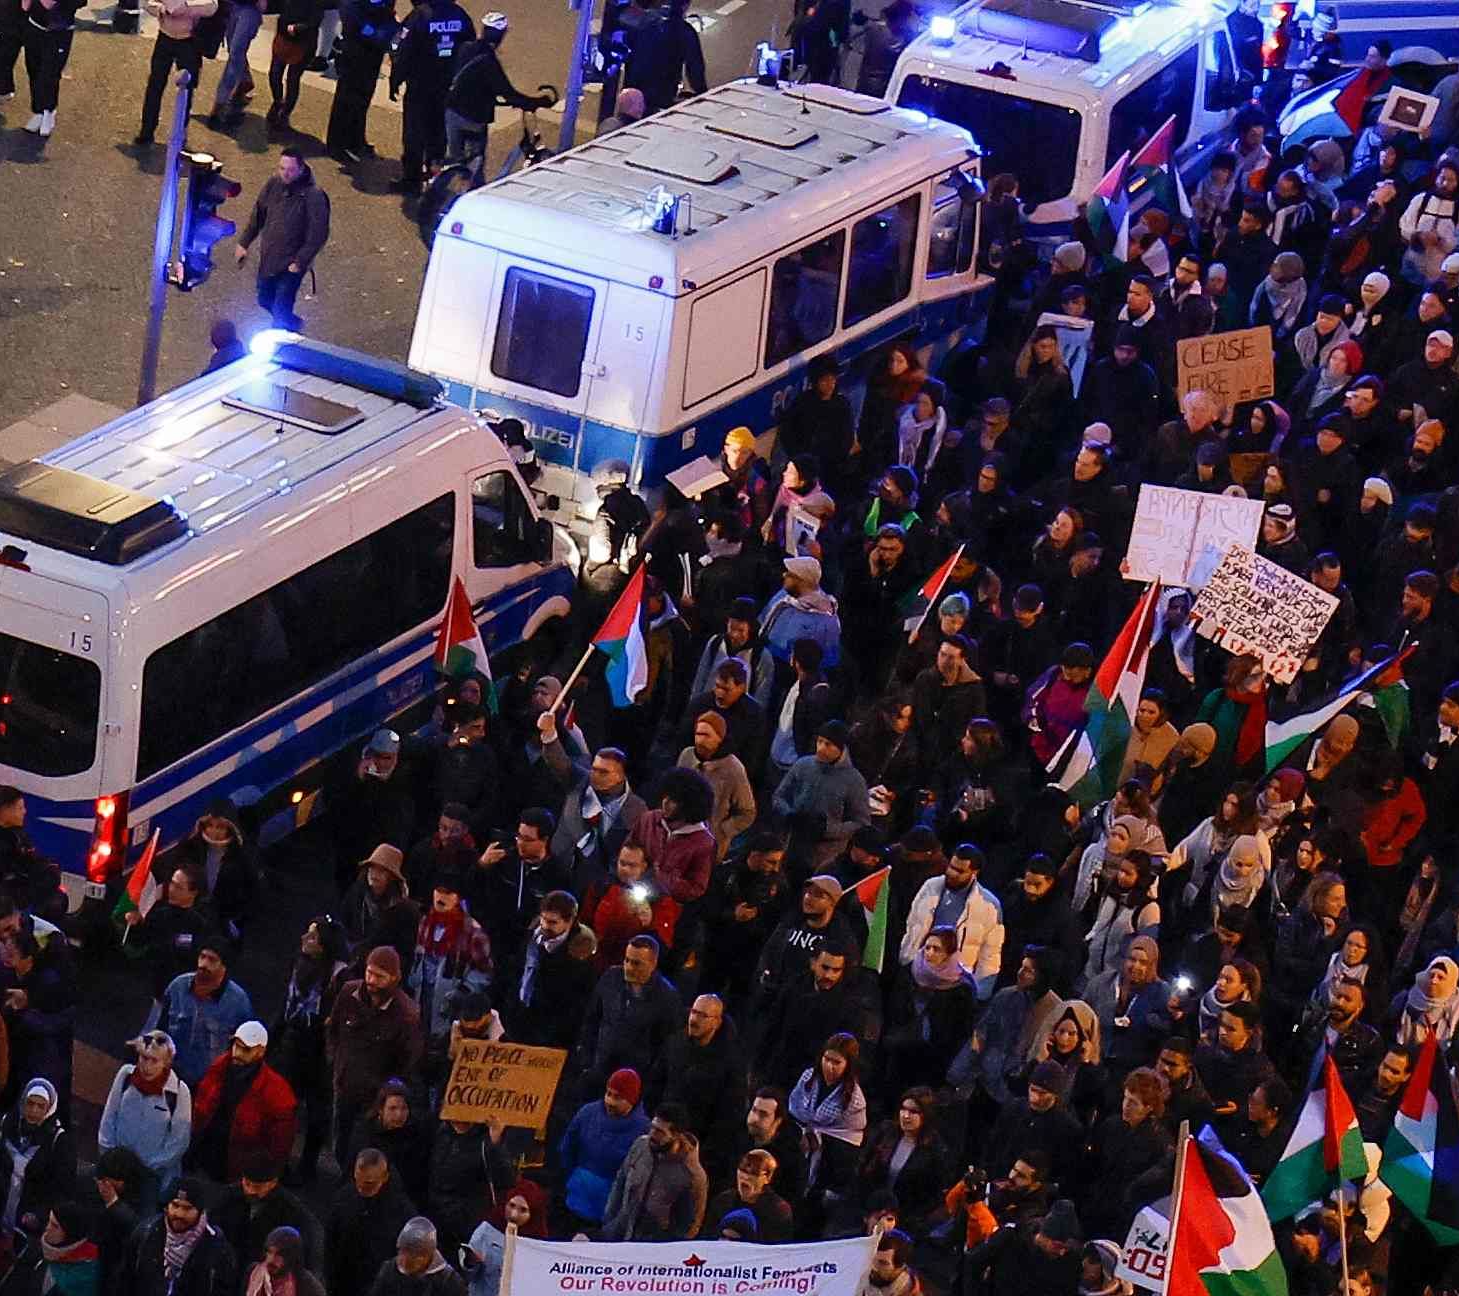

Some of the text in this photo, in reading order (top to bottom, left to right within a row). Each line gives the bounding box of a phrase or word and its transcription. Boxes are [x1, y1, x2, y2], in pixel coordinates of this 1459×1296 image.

[624, 324, 644, 342] 15
[1183, 336, 1255, 367] CEASE
[70, 631, 92, 652] 15
[463, 1045, 480, 1061] NO
[483, 1045, 525, 1065] PEACE
[549, 1262, 612, 1275] Alliance
[617, 1262, 634, 1275] of
[637, 1262, 757, 1280] Internationalist
[559, 1276, 595, 1290] Our
[601, 1276, 705, 1294] Revolution
[712, 1281, 728, 1295] is
